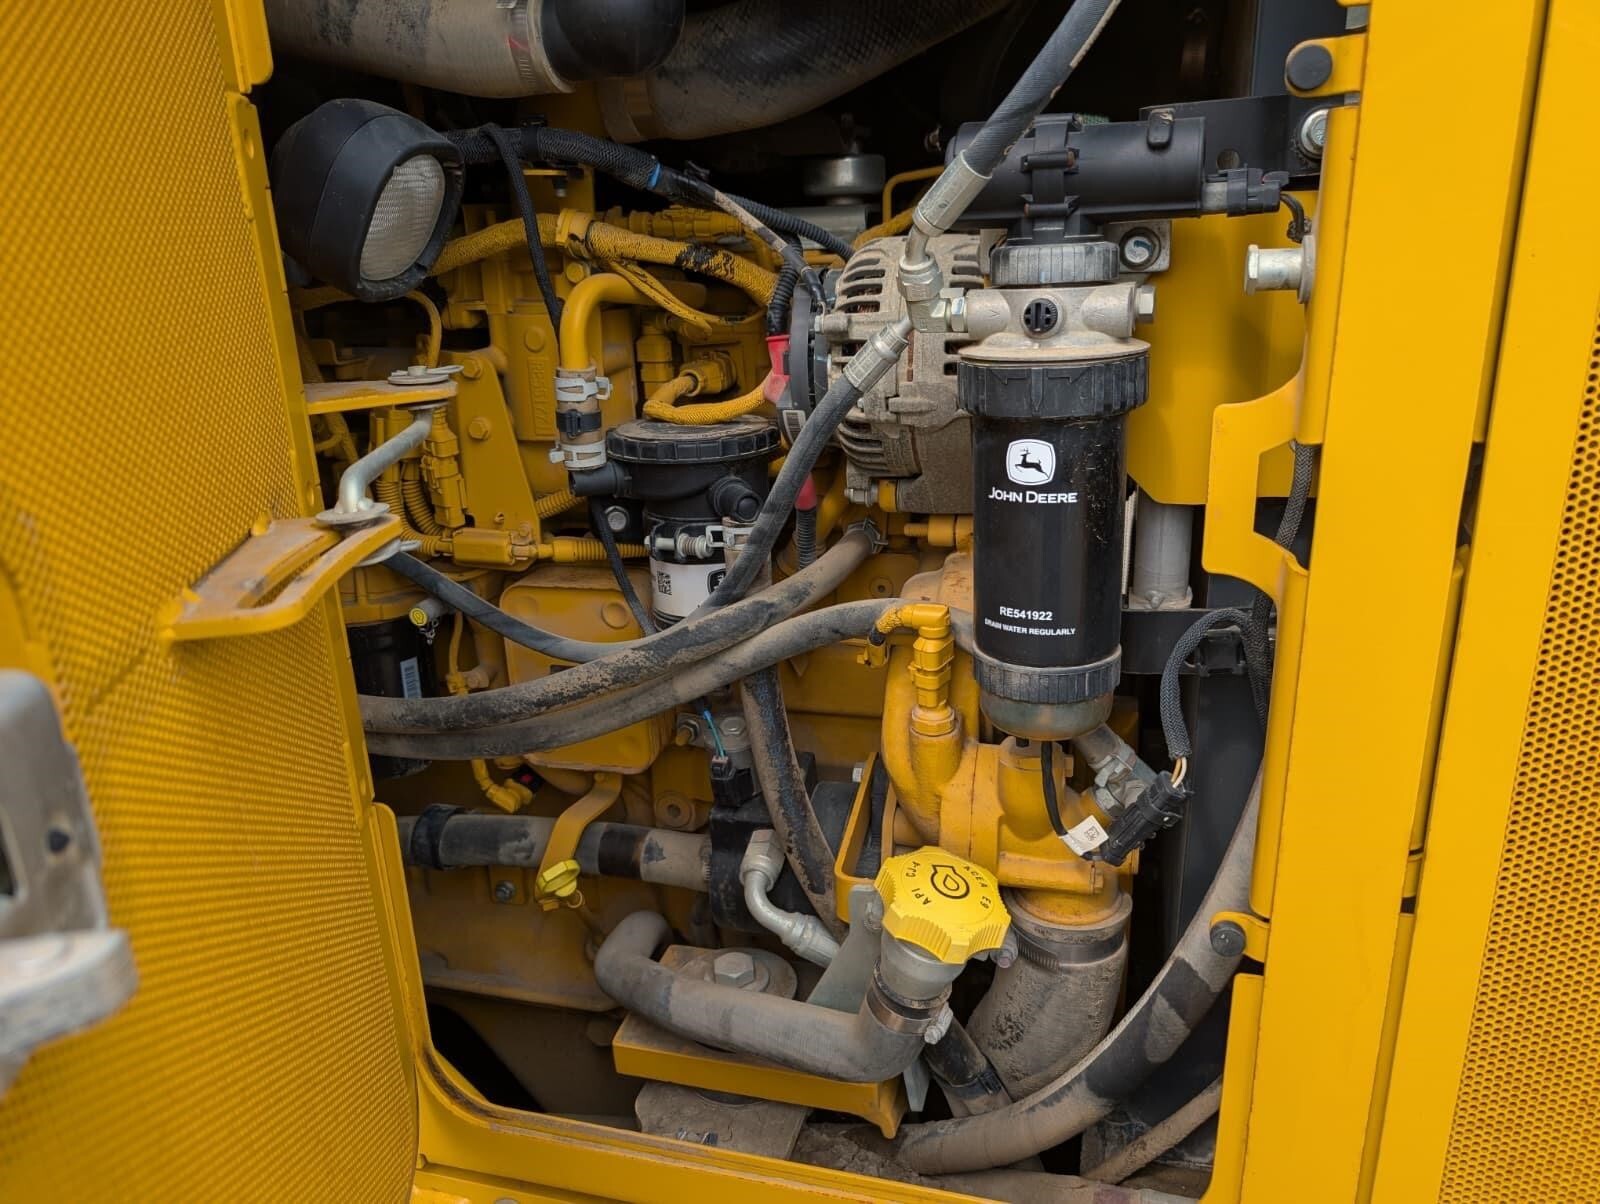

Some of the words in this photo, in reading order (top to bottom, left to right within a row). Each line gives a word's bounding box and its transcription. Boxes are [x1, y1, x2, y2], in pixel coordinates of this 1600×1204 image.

[988, 487, 1023, 503] JOHN
[1025, 490, 1078, 504] DEERE
[999, 606, 1053, 621] RE541922
[1002, 624, 1027, 634] WATER
[1028, 627, 1076, 636] REGULARLY
[964, 866, 988, 888] ACEA
[912, 888, 932, 906] API
